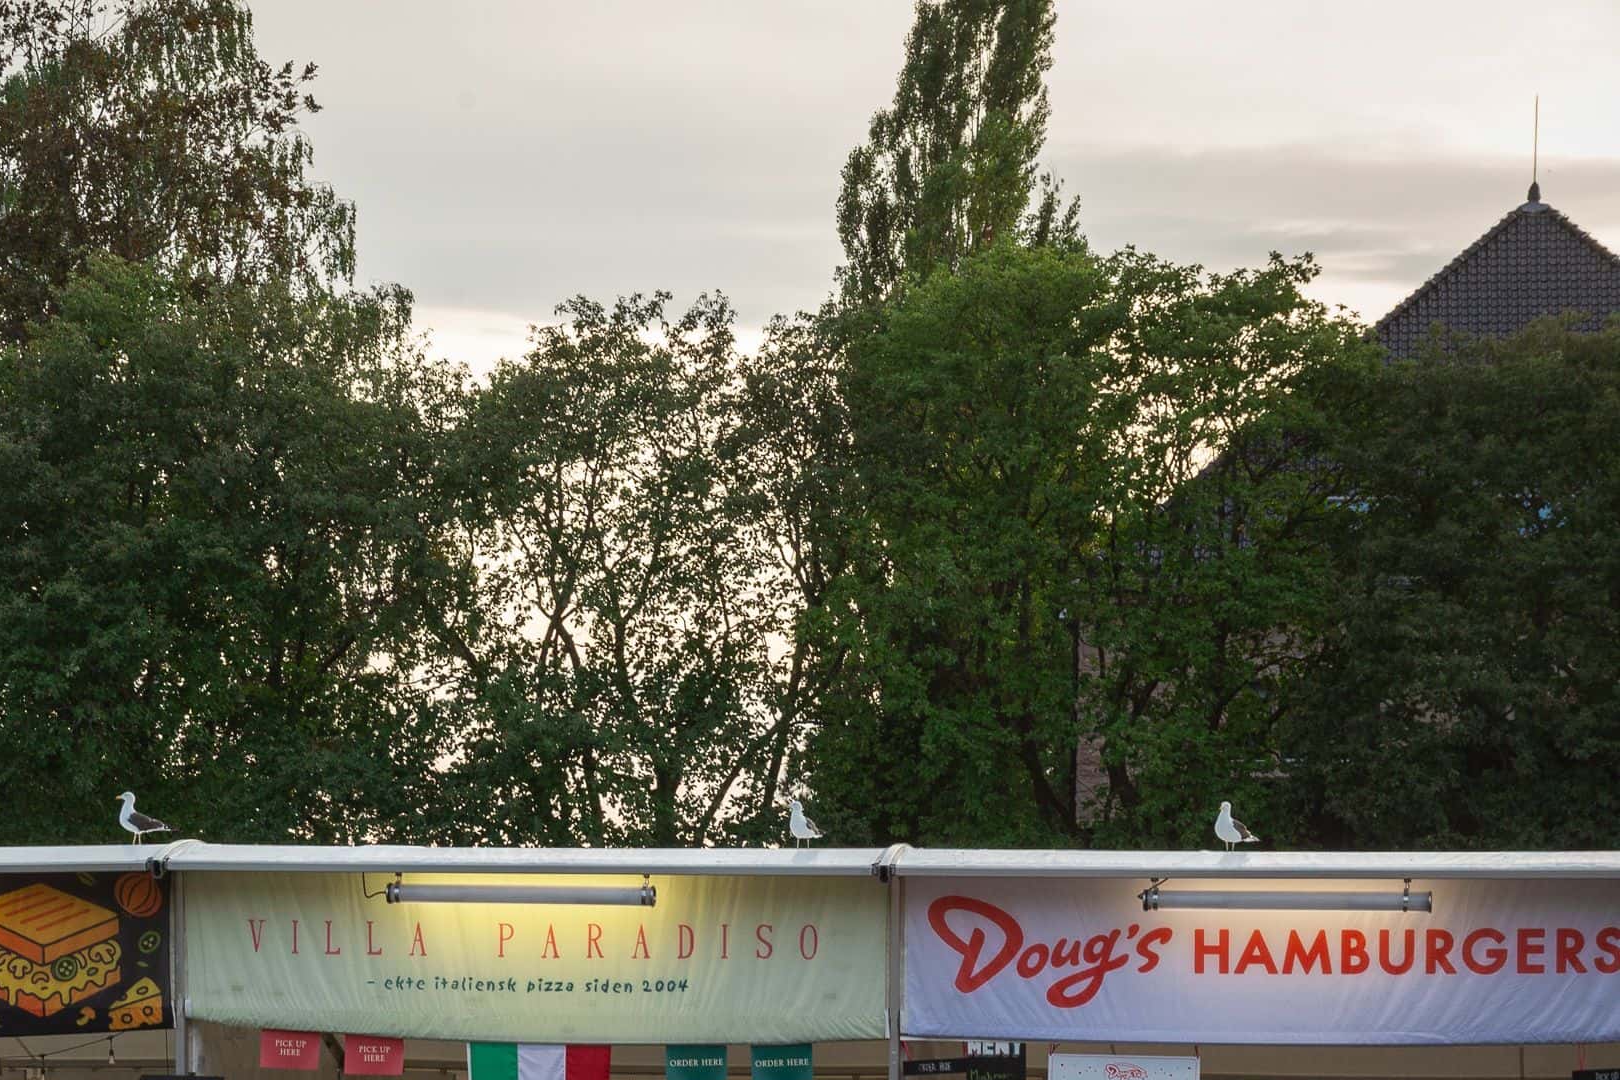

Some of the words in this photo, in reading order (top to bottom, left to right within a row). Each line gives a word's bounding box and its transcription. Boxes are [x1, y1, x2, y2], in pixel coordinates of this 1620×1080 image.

[248, 919, 427, 956] VILLA
[498, 923, 818, 960] PARADISO
[928, 896, 1172, 1008] Doug's
[1193, 928, 1620, 974] HAMBURGERS
[384, 975, 425, 990] ekte
[435, 975, 516, 992] italiensk
[527, 978, 574, 993] pizza
[585, 977, 633, 993] siden
[643, 979, 689, 993] 2004
[275, 1039, 293, 1047] PICK
[280, 1048, 301, 1056] HERE
[359, 1045, 377, 1053] PICK
[364, 1054, 385, 1062] HERE
[670, 1058, 699, 1067] ORDER
[702, 1058, 723, 1066] HERE
[755, 1060, 784, 1068] ORDER
[787, 1058, 809, 1066] HERE
